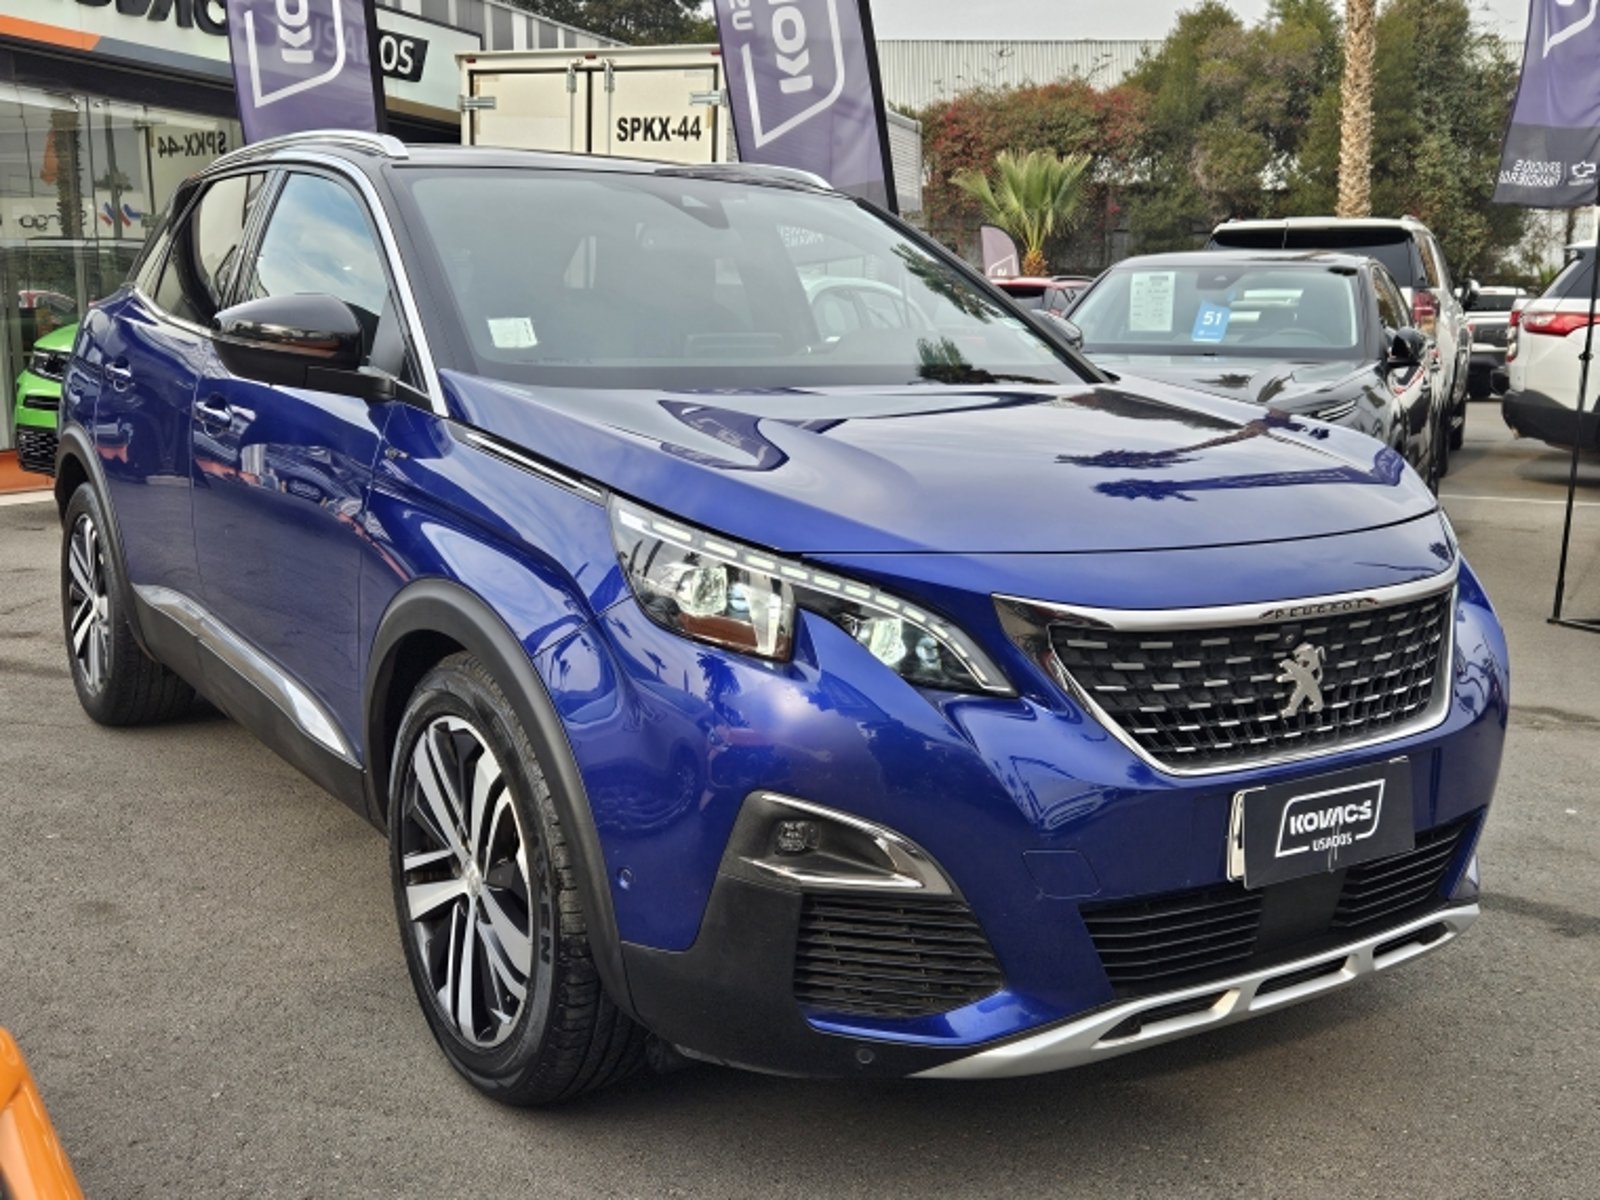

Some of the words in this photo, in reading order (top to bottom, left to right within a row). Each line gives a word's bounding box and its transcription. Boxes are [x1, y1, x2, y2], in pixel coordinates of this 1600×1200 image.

[616, 115, 702, 142] SPKX-44
[1201, 310, 1223, 326] 51
[1289, 799, 1373, 836] KOVACS
[1312, 832, 1353, 852] USADOS
